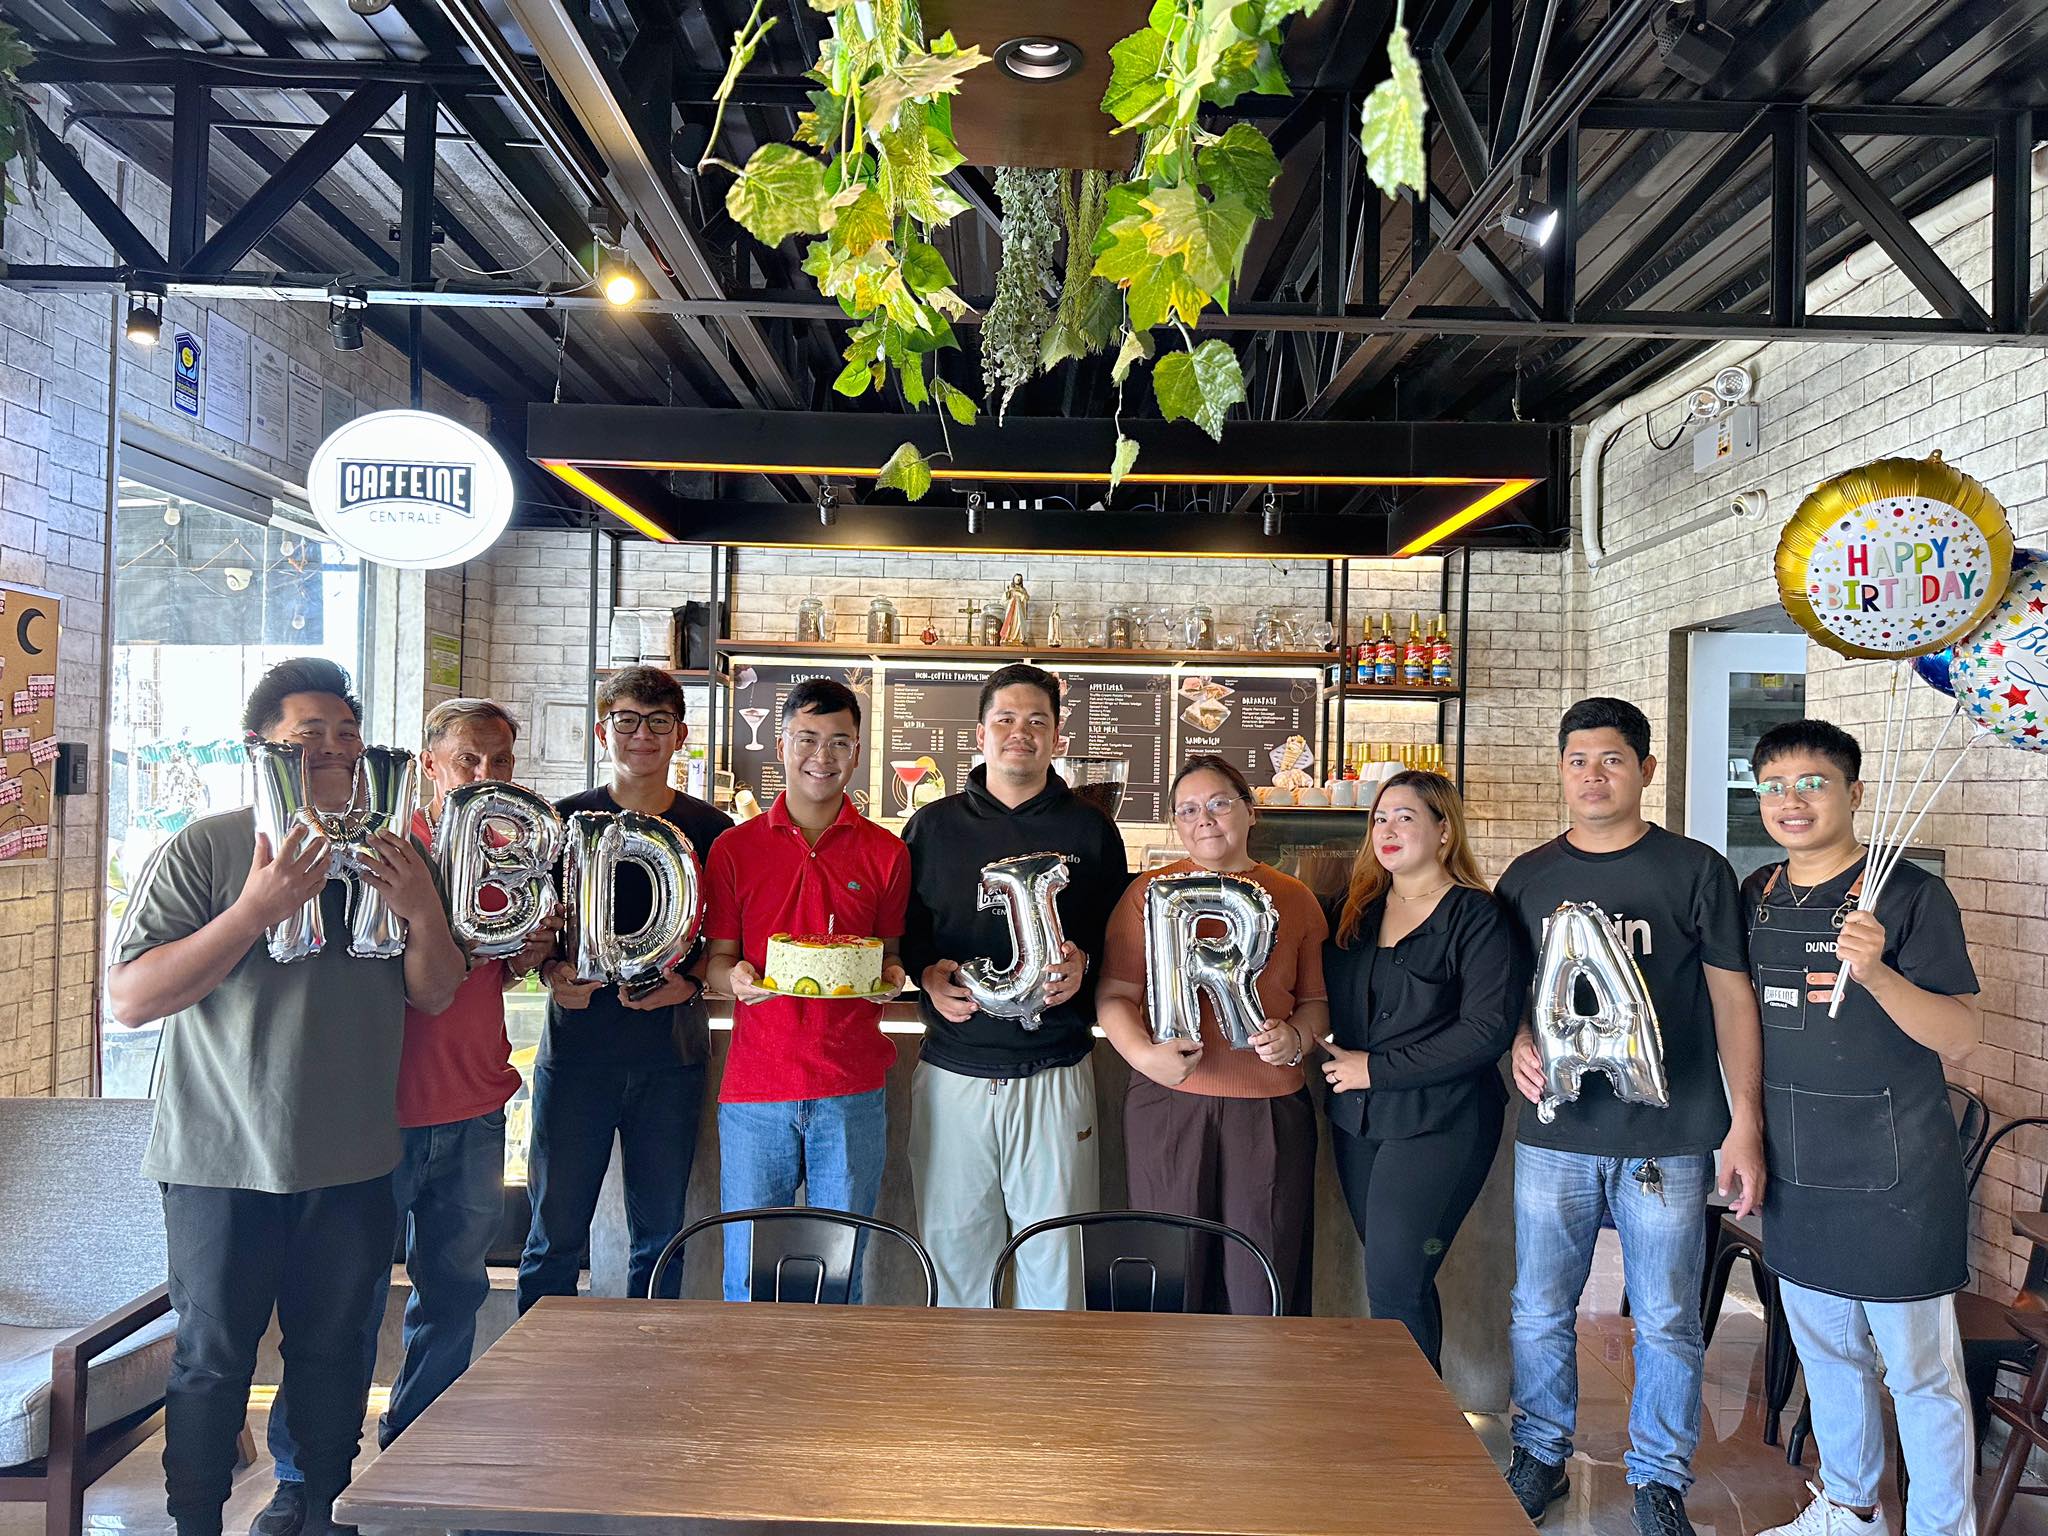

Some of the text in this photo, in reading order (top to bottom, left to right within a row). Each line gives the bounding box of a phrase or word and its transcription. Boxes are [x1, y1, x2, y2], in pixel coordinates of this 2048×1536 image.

[345, 464, 467, 508] CAFFEINE
[370, 510, 441, 525] CENTRALE
[1847, 536, 1950, 578] HAPPY
[1824, 570, 1977, 613] BIRTHDAY
[1241, 697, 1278, 706] BREAKFAST
[1185, 737, 1221, 746] SANDWICH
[434, 779, 566, 959] B
[561, 810, 706, 986] D
[953, 852, 1072, 1031] J
[1142, 870, 1281, 1051] R
[1532, 900, 1670, 1124] A
